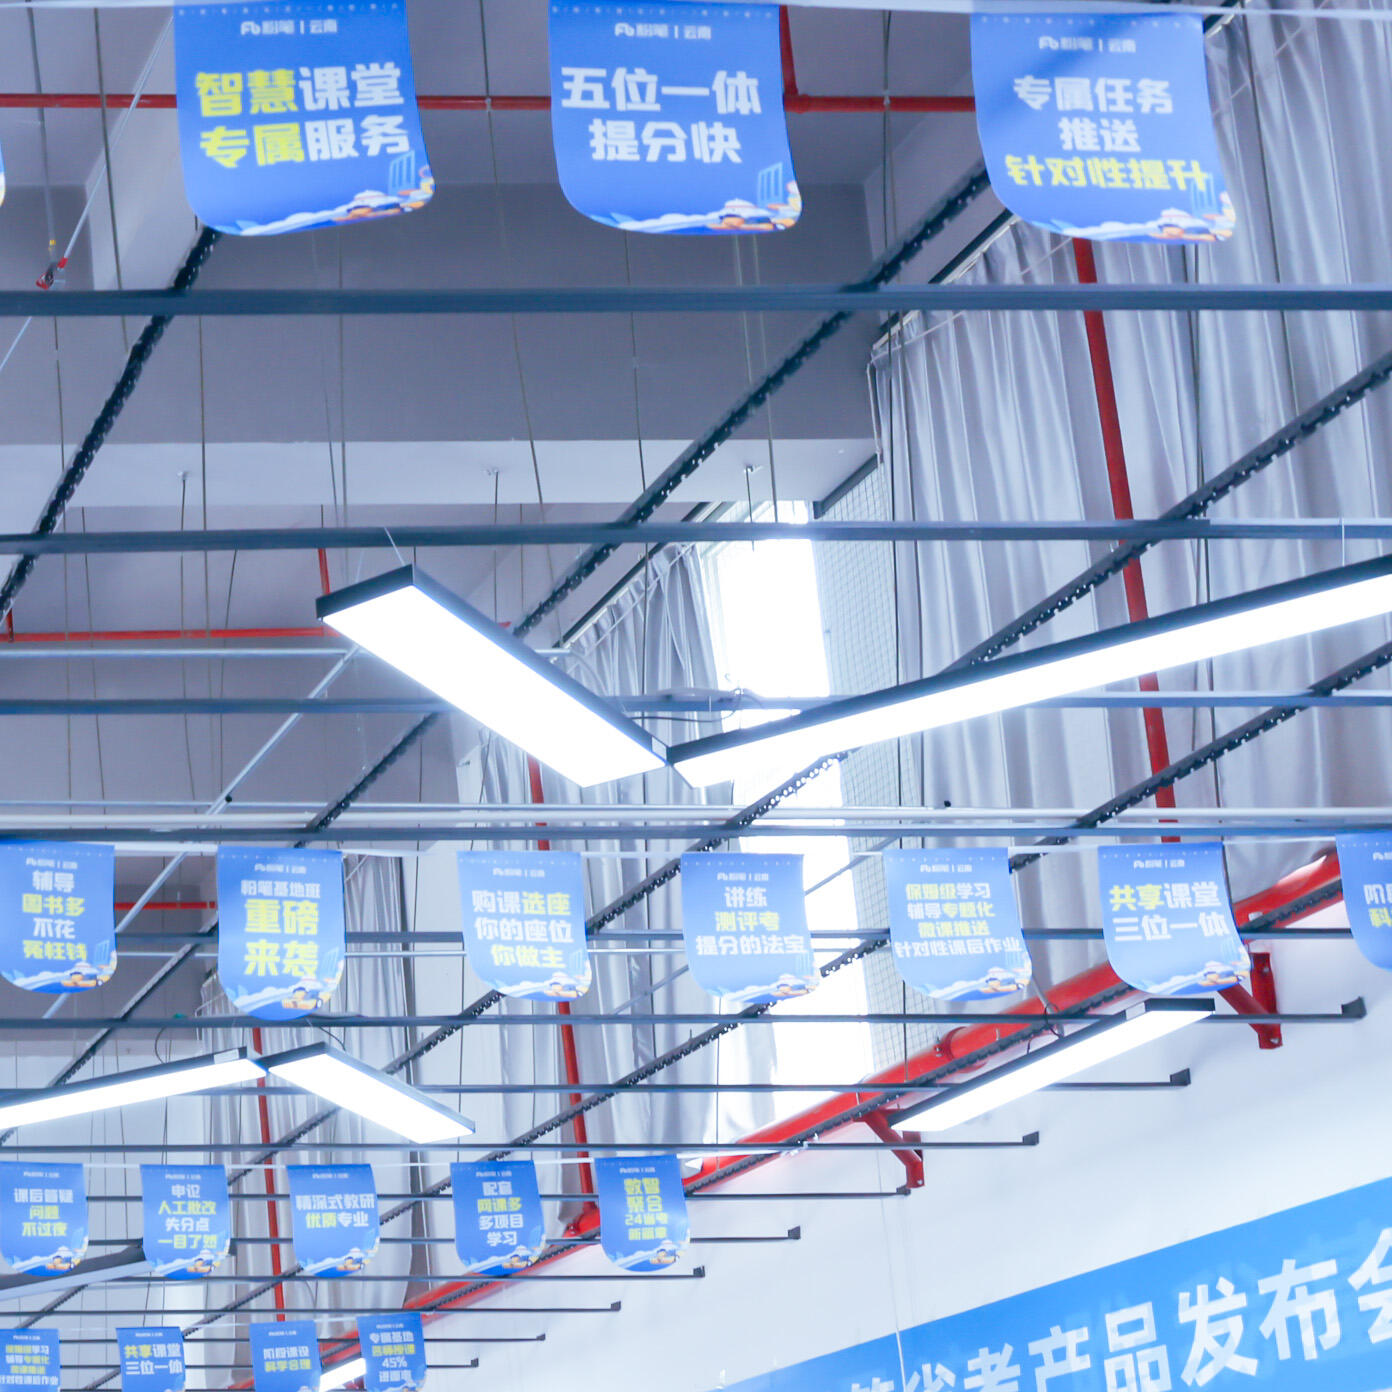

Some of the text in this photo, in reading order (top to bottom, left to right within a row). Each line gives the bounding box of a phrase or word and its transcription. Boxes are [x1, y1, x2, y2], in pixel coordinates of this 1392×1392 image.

[195, 63, 405, 117] 智慧课堂
[561, 67, 762, 115] 五位一体
[1013, 75, 1174, 114] 专属任务
[200, 115, 411, 168] 专属服务
[589, 118, 743, 162] 提分快
[1059, 117, 1141, 152] 推送
[1005, 155, 1212, 191] 针对性提升
[32, 871, 75, 893] 辅导
[1110, 881, 1222, 911] 共享课堂
[22, 894, 86, 916] 图书多
[472, 890, 572, 917] 购课选座
[724, 887, 768, 908] 讲练
[33, 917, 76, 939] 不花
[244, 899, 320, 936] 重磅
[474, 918, 575, 944] 你的座位
[715, 911, 780, 932] 测评考
[1113, 912, 1231, 942] 三位一体
[244, 939, 321, 979] 来袭
[490, 944, 567, 968] 你做主
[696, 934, 809, 956] 提分的法宝
